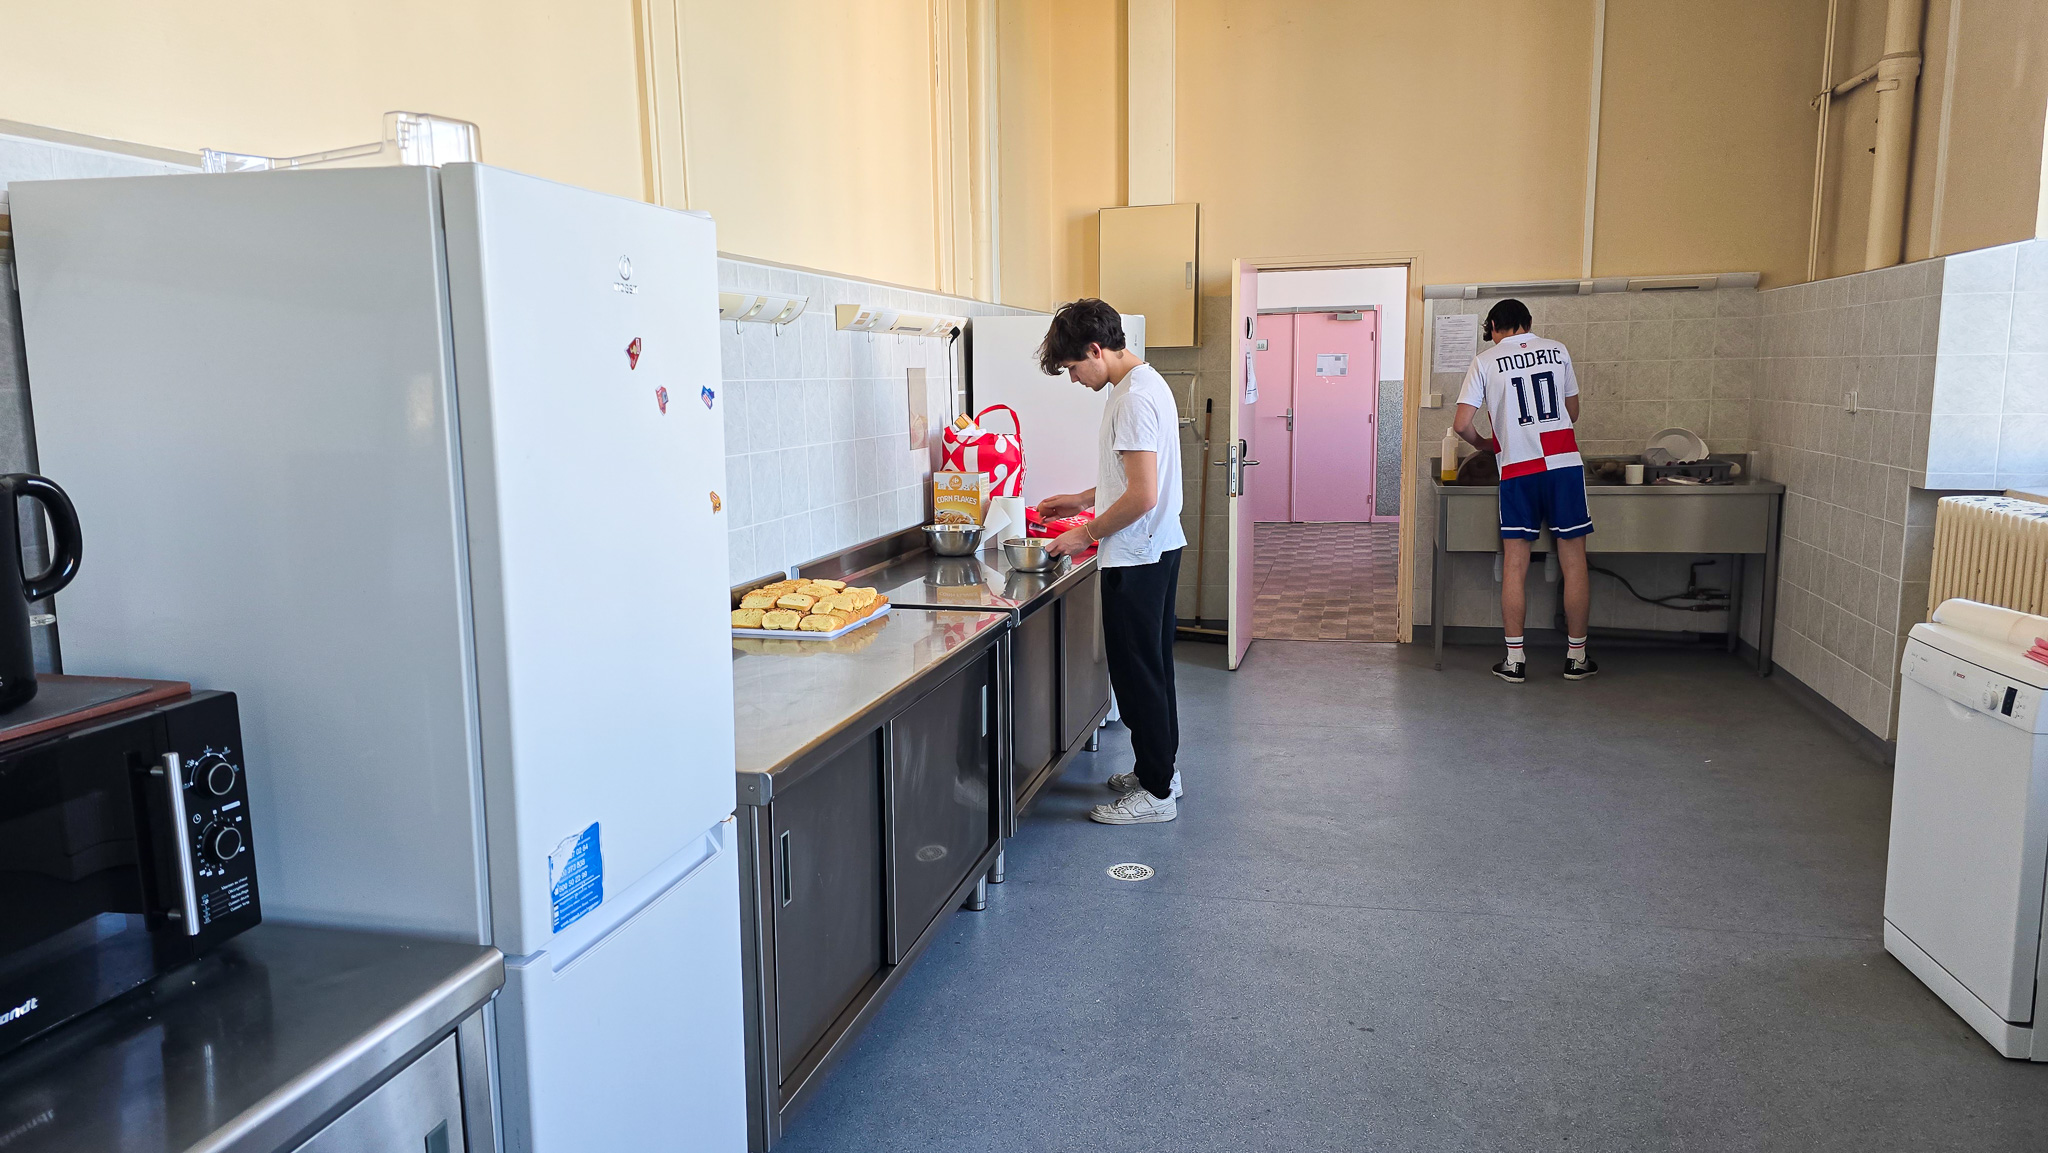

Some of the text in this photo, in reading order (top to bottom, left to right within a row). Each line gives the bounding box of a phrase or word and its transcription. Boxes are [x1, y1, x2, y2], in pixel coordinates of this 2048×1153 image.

[1511, 371, 1560, 427] 10
[936, 495, 978, 505] CORN FLAKES
